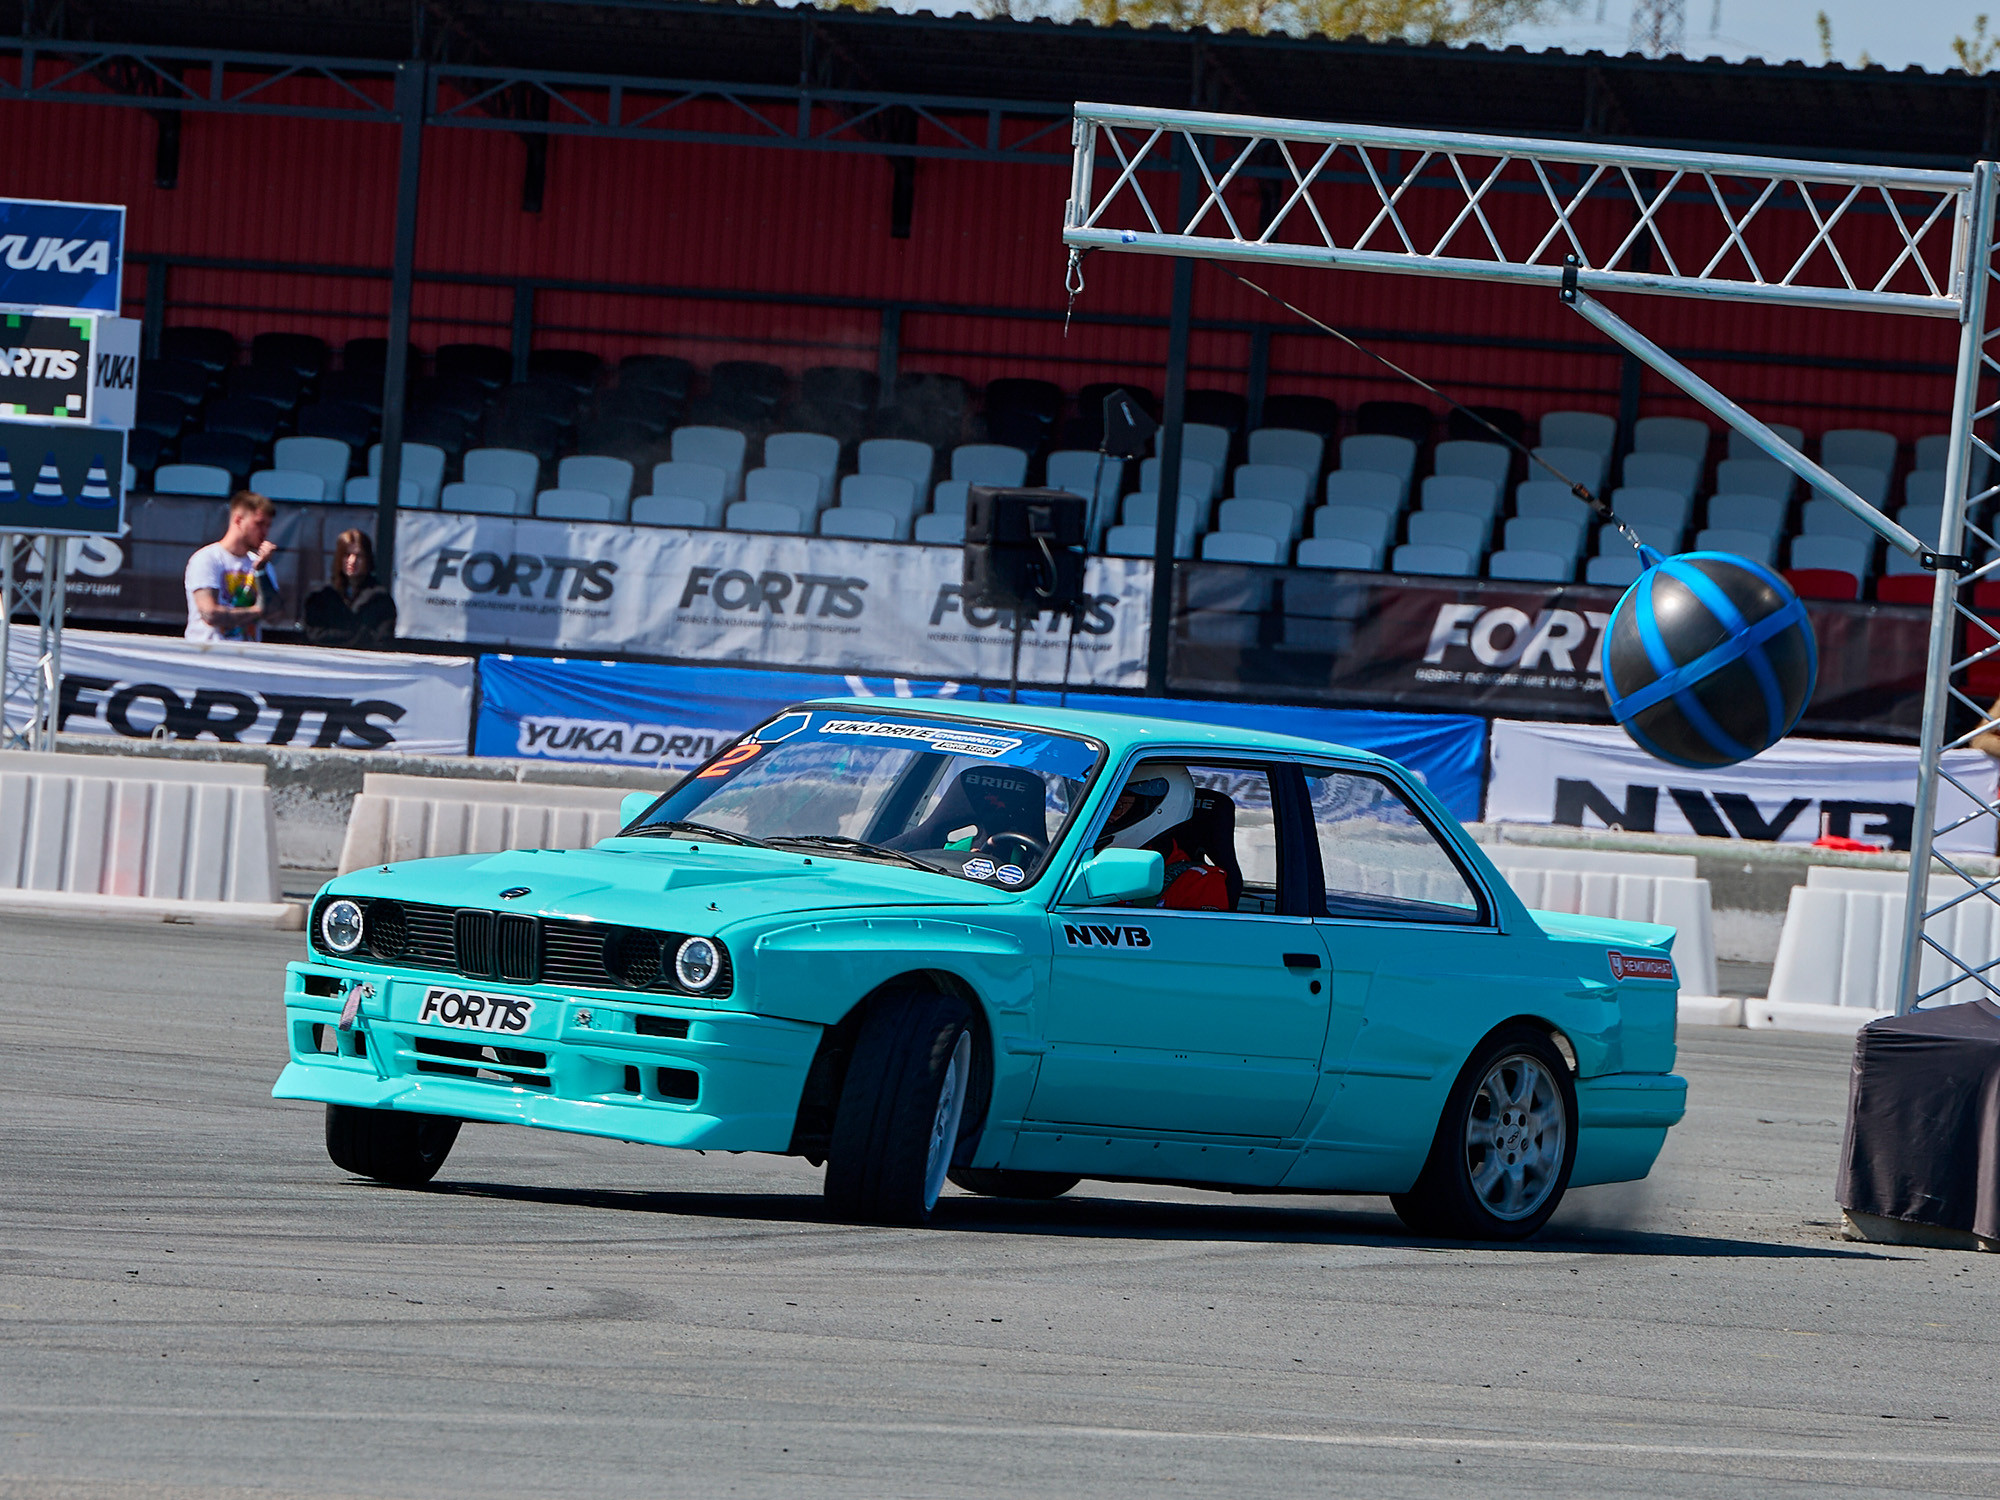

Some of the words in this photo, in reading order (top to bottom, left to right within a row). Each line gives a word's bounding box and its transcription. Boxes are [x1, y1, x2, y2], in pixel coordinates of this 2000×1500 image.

[428, 548, 618, 602] FORTIS
[679, 567, 868, 619] FORTIS
[1423, 603, 1610, 673] FORT
[46, 675, 407, 750] FORTIS
[825, 722, 874, 733] YUKA
[874, 724, 933, 739] DRIVE
[527, 723, 623, 752] YUKA
[630, 732, 735, 759] DRIV
[697, 744, 762, 779] 2
[966, 773, 1028, 793] BRIDE
[1552, 778, 1914, 852] NWB
[1063, 924, 1152, 947] NWB
[421, 990, 531, 1031] FORTIS
